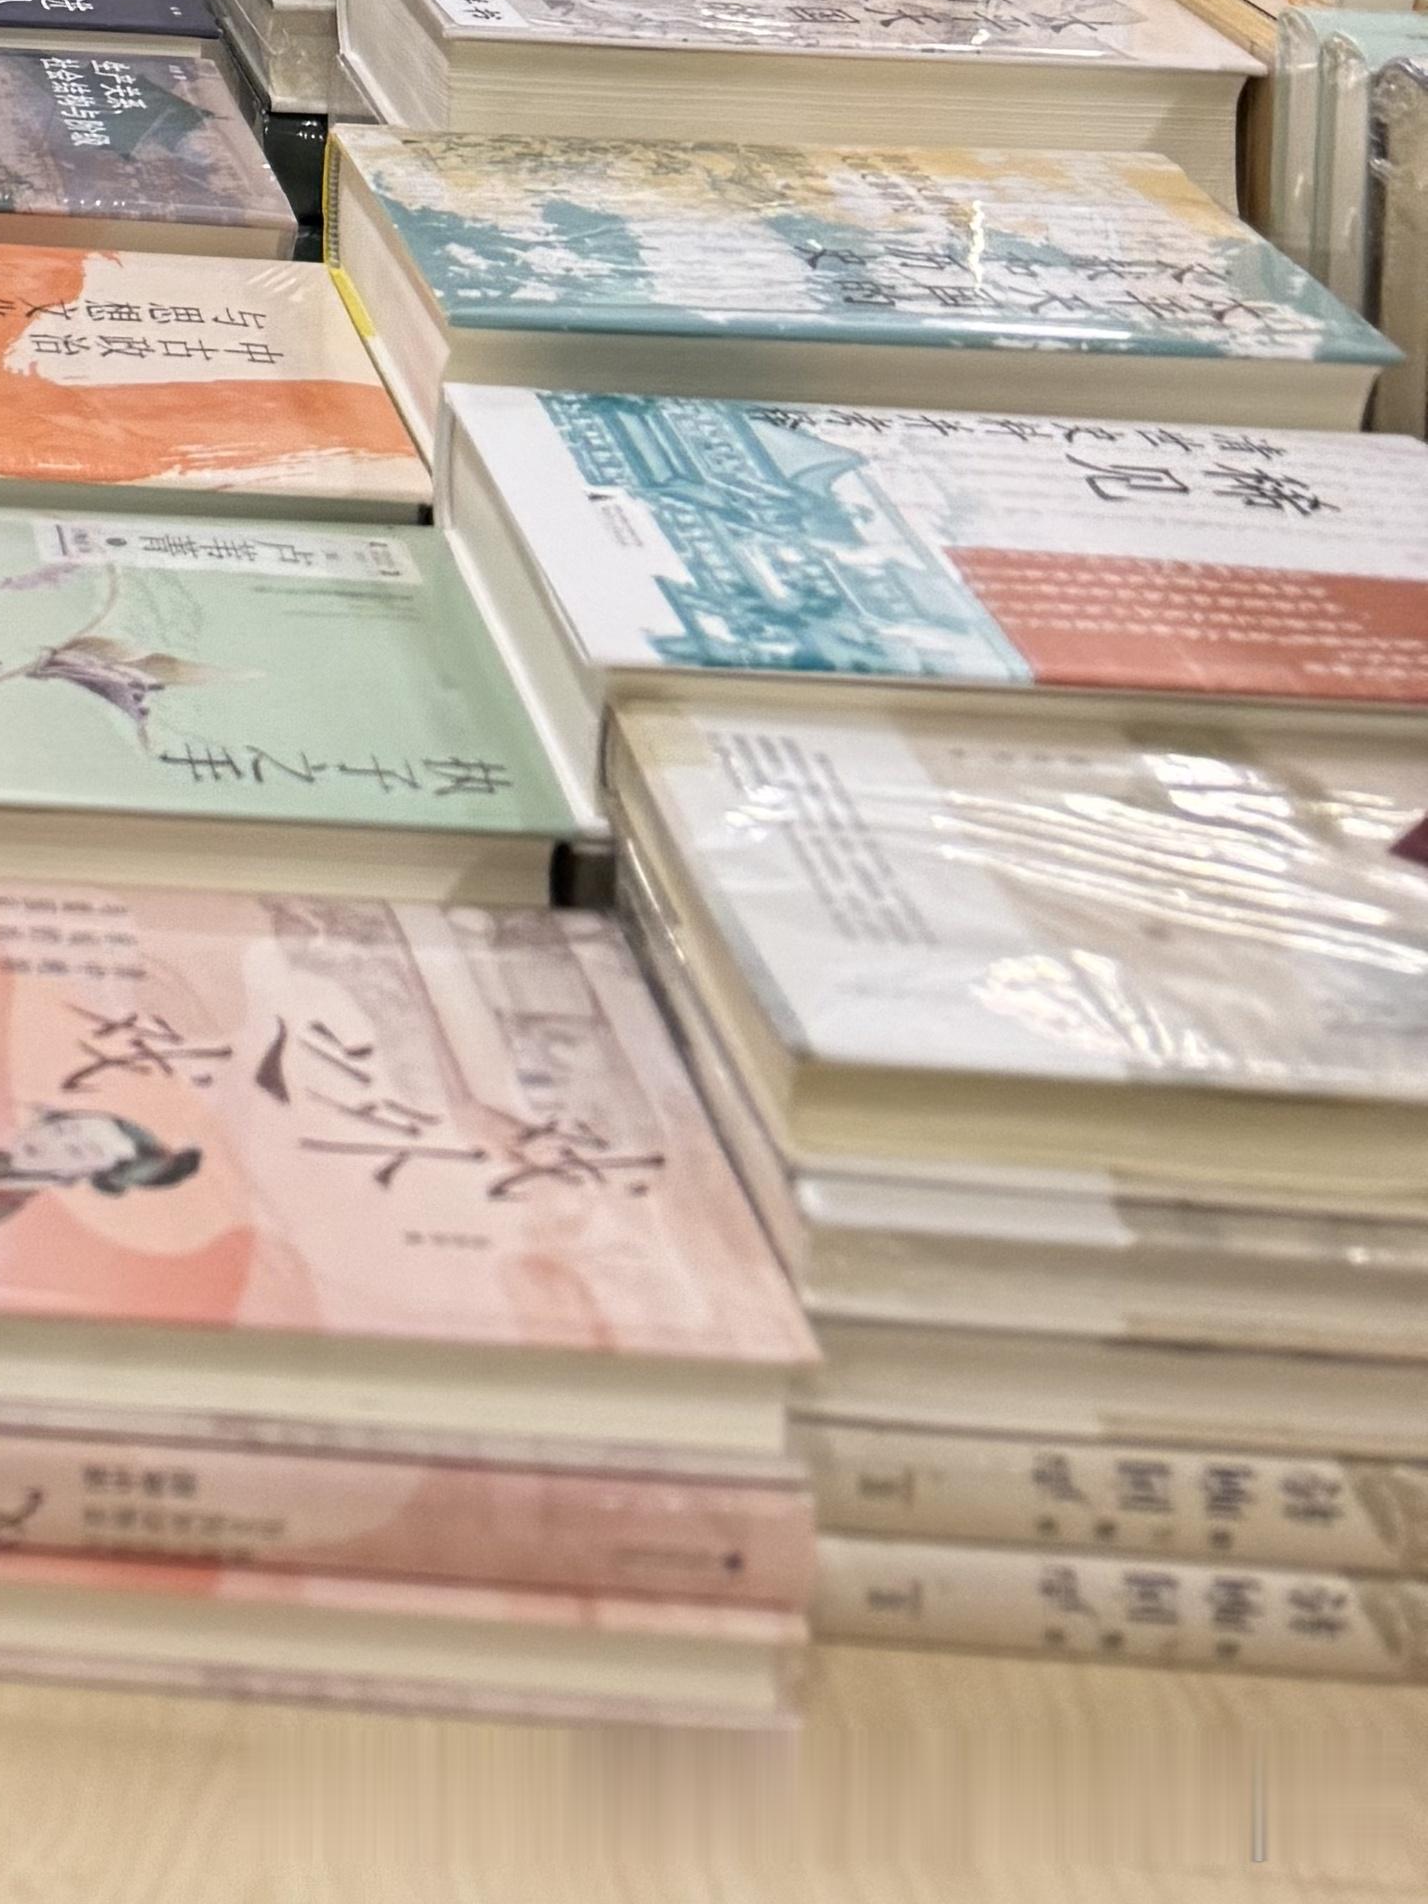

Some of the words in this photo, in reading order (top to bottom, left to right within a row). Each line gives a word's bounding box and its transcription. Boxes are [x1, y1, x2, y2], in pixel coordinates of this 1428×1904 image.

[89, 59, 148, 114] 生产关系、
[29, 332, 282, 368] 中古政治
[1066, 454, 1340, 517] 稀见
[161, 741, 513, 796] 执子之手
